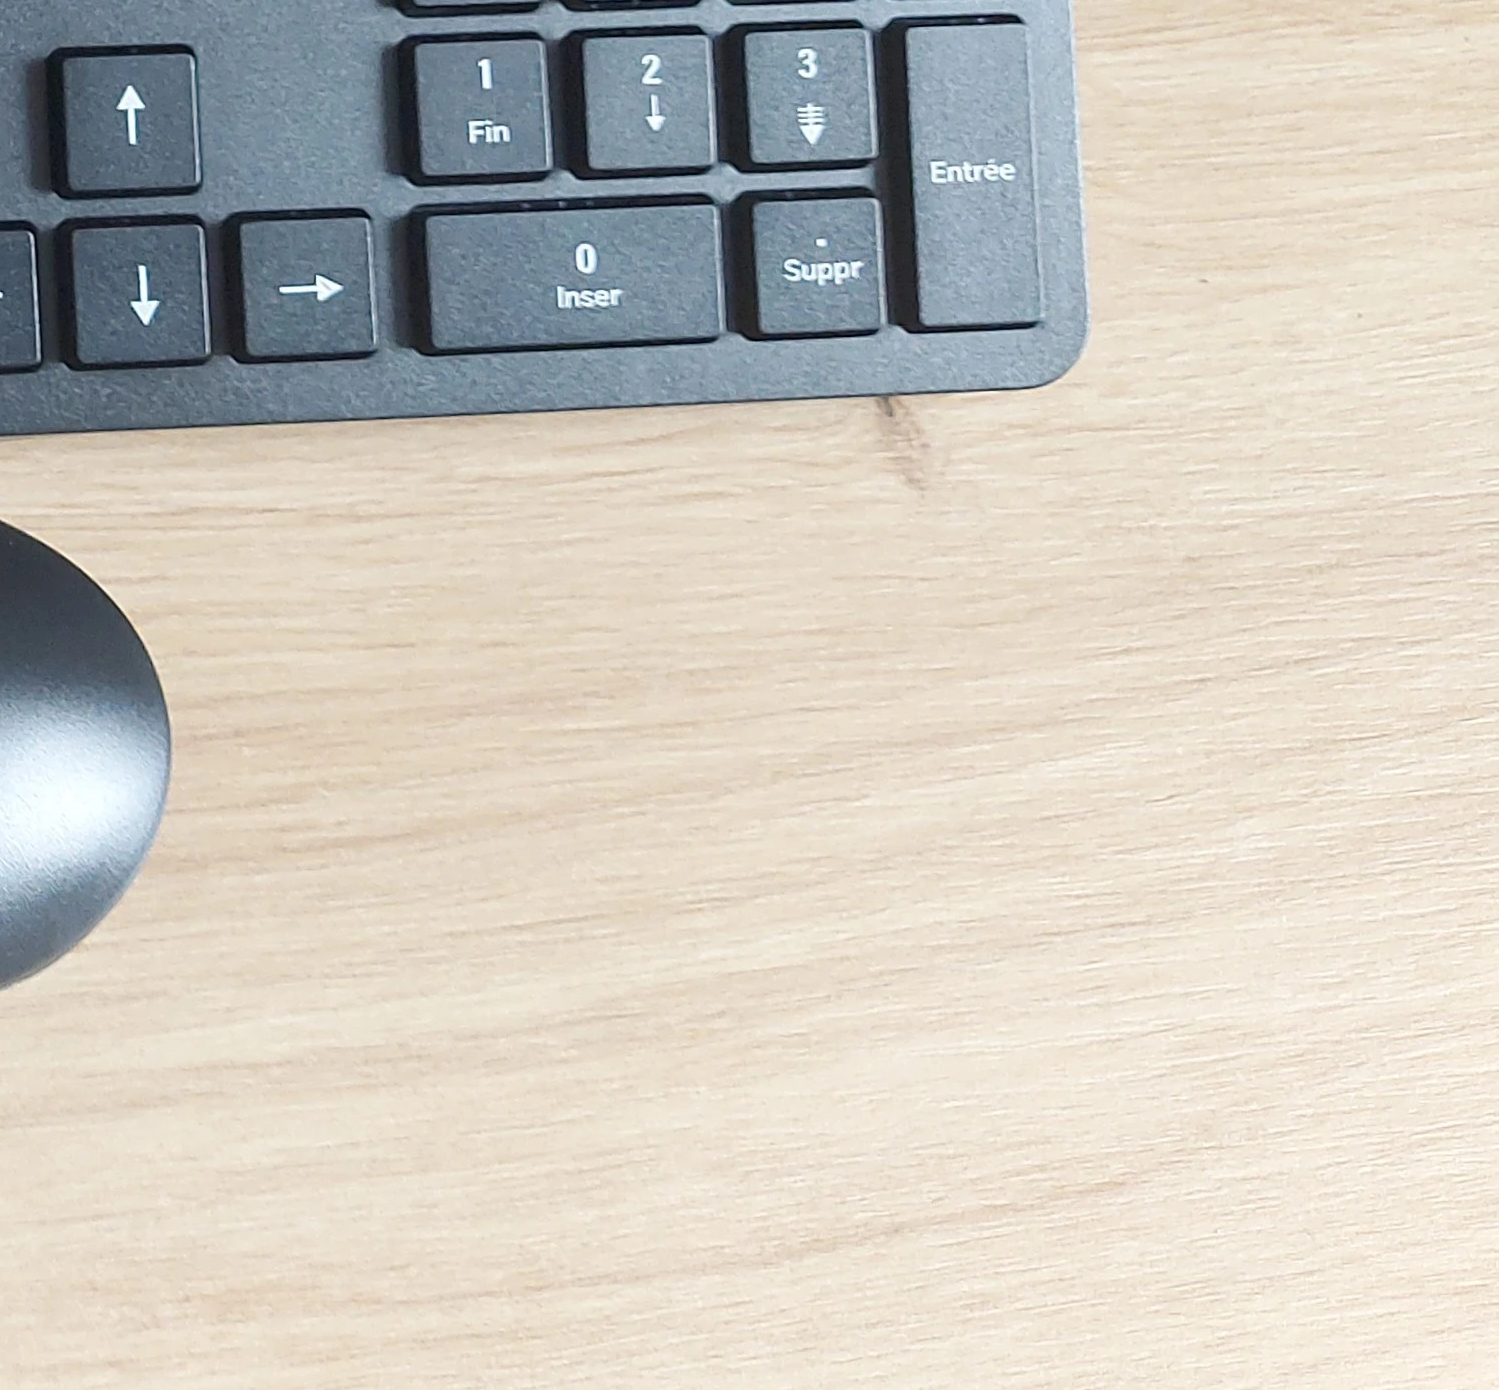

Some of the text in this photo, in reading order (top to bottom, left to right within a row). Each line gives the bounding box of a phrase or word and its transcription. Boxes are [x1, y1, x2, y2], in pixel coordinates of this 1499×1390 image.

[477, 58, 492, 90] 1
[641, 54, 663, 85] 2
[797, 48, 818, 79] 3
[468, 119, 511, 144] Fin
[930, 158, 1016, 184] Entrée
[575, 243, 597, 274] 0
[782, 258, 865, 286] Suppr
[556, 285, 624, 309] Inser
